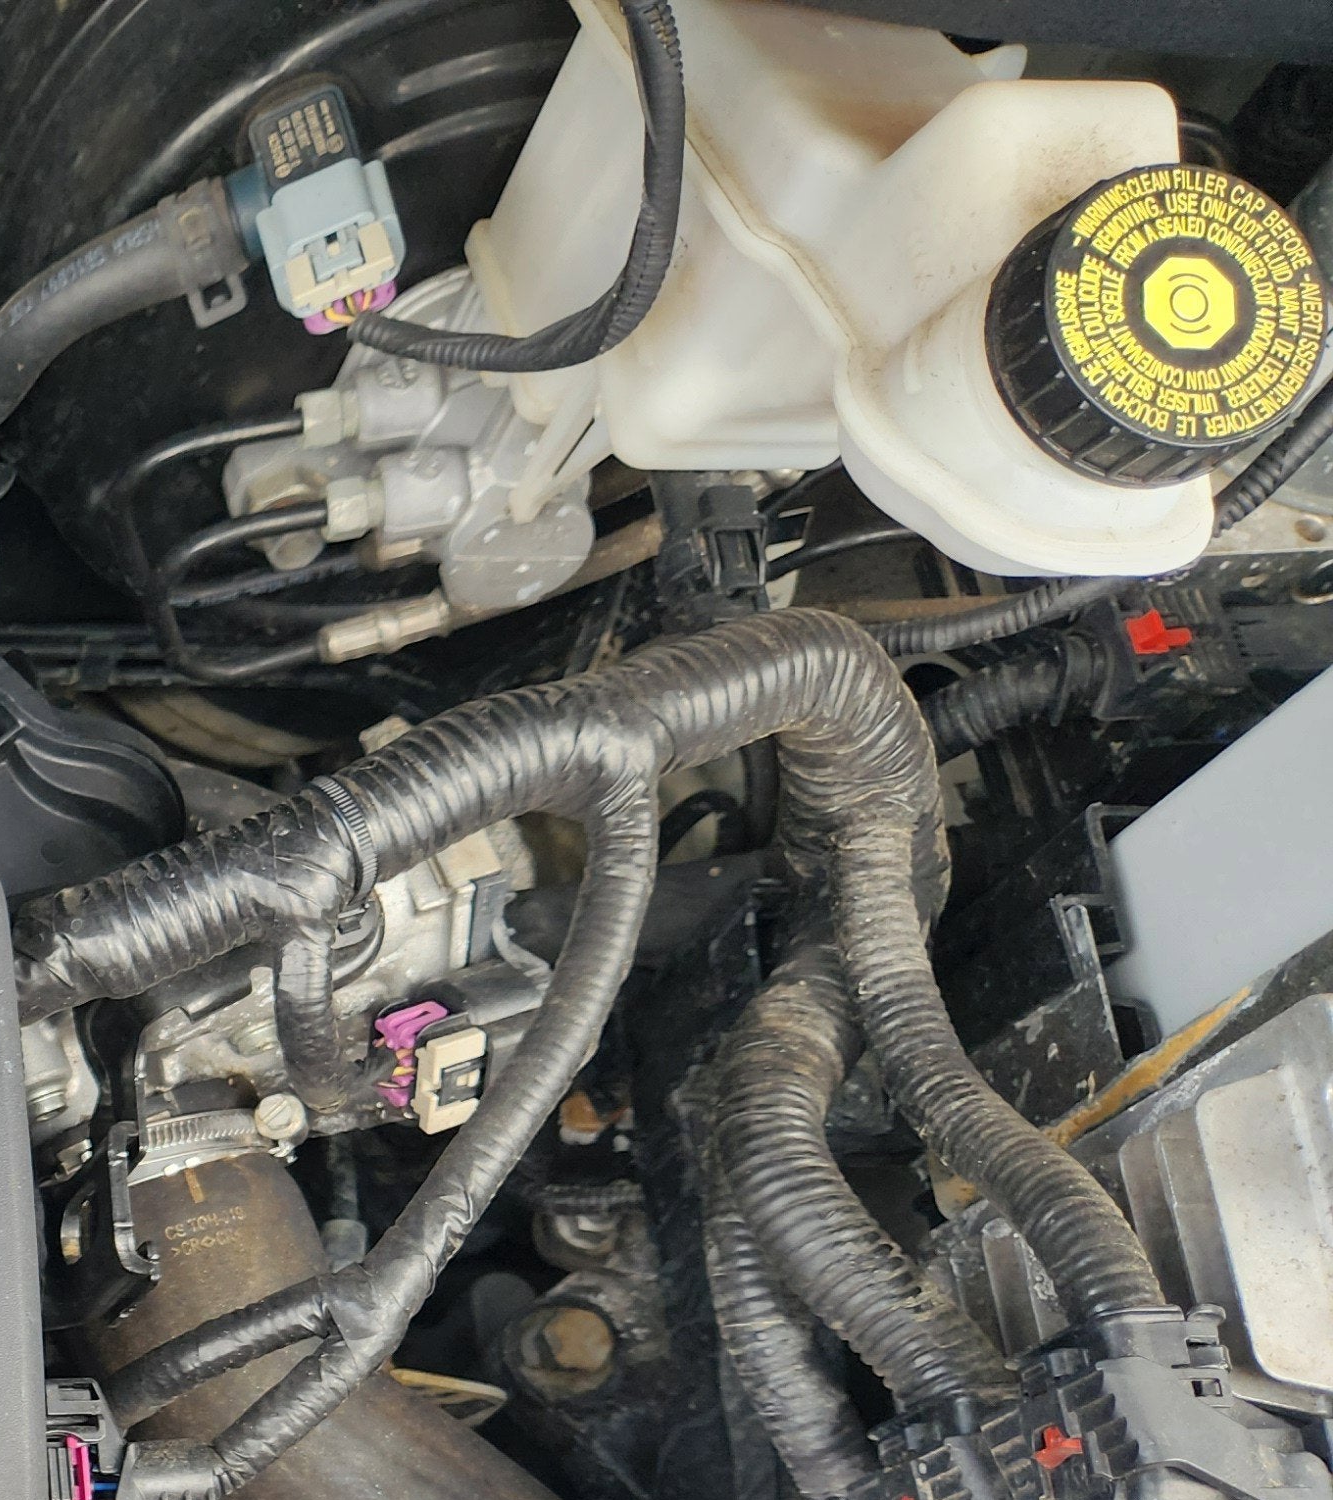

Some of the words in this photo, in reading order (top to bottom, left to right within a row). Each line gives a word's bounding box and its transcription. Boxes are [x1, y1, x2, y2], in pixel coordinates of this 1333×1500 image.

[1165, 192, 1199, 214] USE
[1201, 196, 1239, 224] ONLY
[1173, 169, 1227, 197] FILLER
[1230, 184, 1266, 213] CAP
[1262, 209, 1312, 270] BEFORE
[1233, 212, 1264, 240] DOT
[1111, 230, 1148, 269] FROM
[1144, 224, 1159, 244] A
[1155, 216, 1206, 239] SEALED
[1254, 234, 1270, 248] 4
[1259, 241, 1293, 283] FLUID
[1253, 281, 1277, 307] DOT
[1055, 270, 1095, 364] REMPLISSAGE
[1255, 307, 1277, 317] 4
[1277, 286, 1300, 335] AVANT
[1108, 325, 1184, 389] CONTENANT
[1218, 317, 1276, 386] PROVENANT
[1270, 338, 1295, 362] DE
[1080, 360, 1108, 387] DE
[1089, 336, 1156, 401] SEULEMENT
[1100, 381, 1169, 431] BOUCHON
[1157, 387, 1218, 414] UTILISER
[1175, 415, 1196, 437] LE
